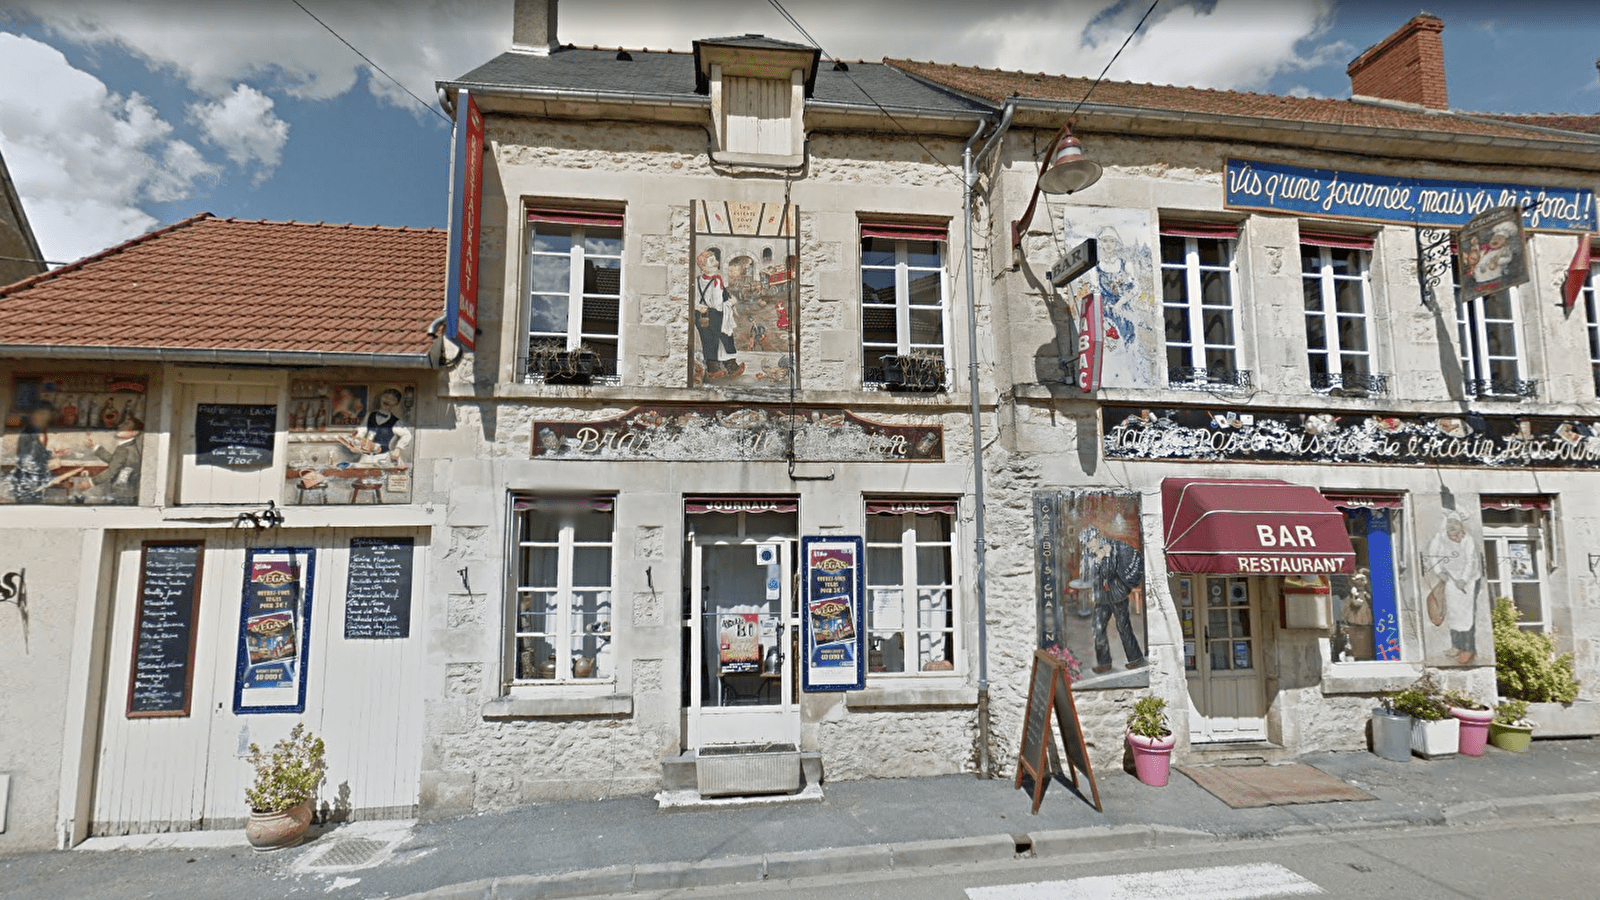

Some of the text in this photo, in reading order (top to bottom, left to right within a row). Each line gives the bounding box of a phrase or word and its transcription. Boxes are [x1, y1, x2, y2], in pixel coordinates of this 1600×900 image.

[1229, 165, 1262, 196] Vis
[1265, 173, 1320, 205] q'une
[1418, 187, 1464, 215] mais
[464, 133, 478, 291] RESTAURANT
[1053, 249, 1082, 278] BAR
[460, 293, 476, 320] BAR
[1079, 298, 1091, 390] TABAC
[706, 500, 778, 510] JOURNAUX
[891, 503, 930, 511] TABAC
[1256, 525, 1316, 547] BAR
[816, 560, 849, 570] VEGAS
[1237, 557, 1346, 573] RESTAURANT
[259, 573, 293, 583] VEGAS
[815, 602, 846, 615] VEGAS
[253, 619, 288, 632] VEGAS
